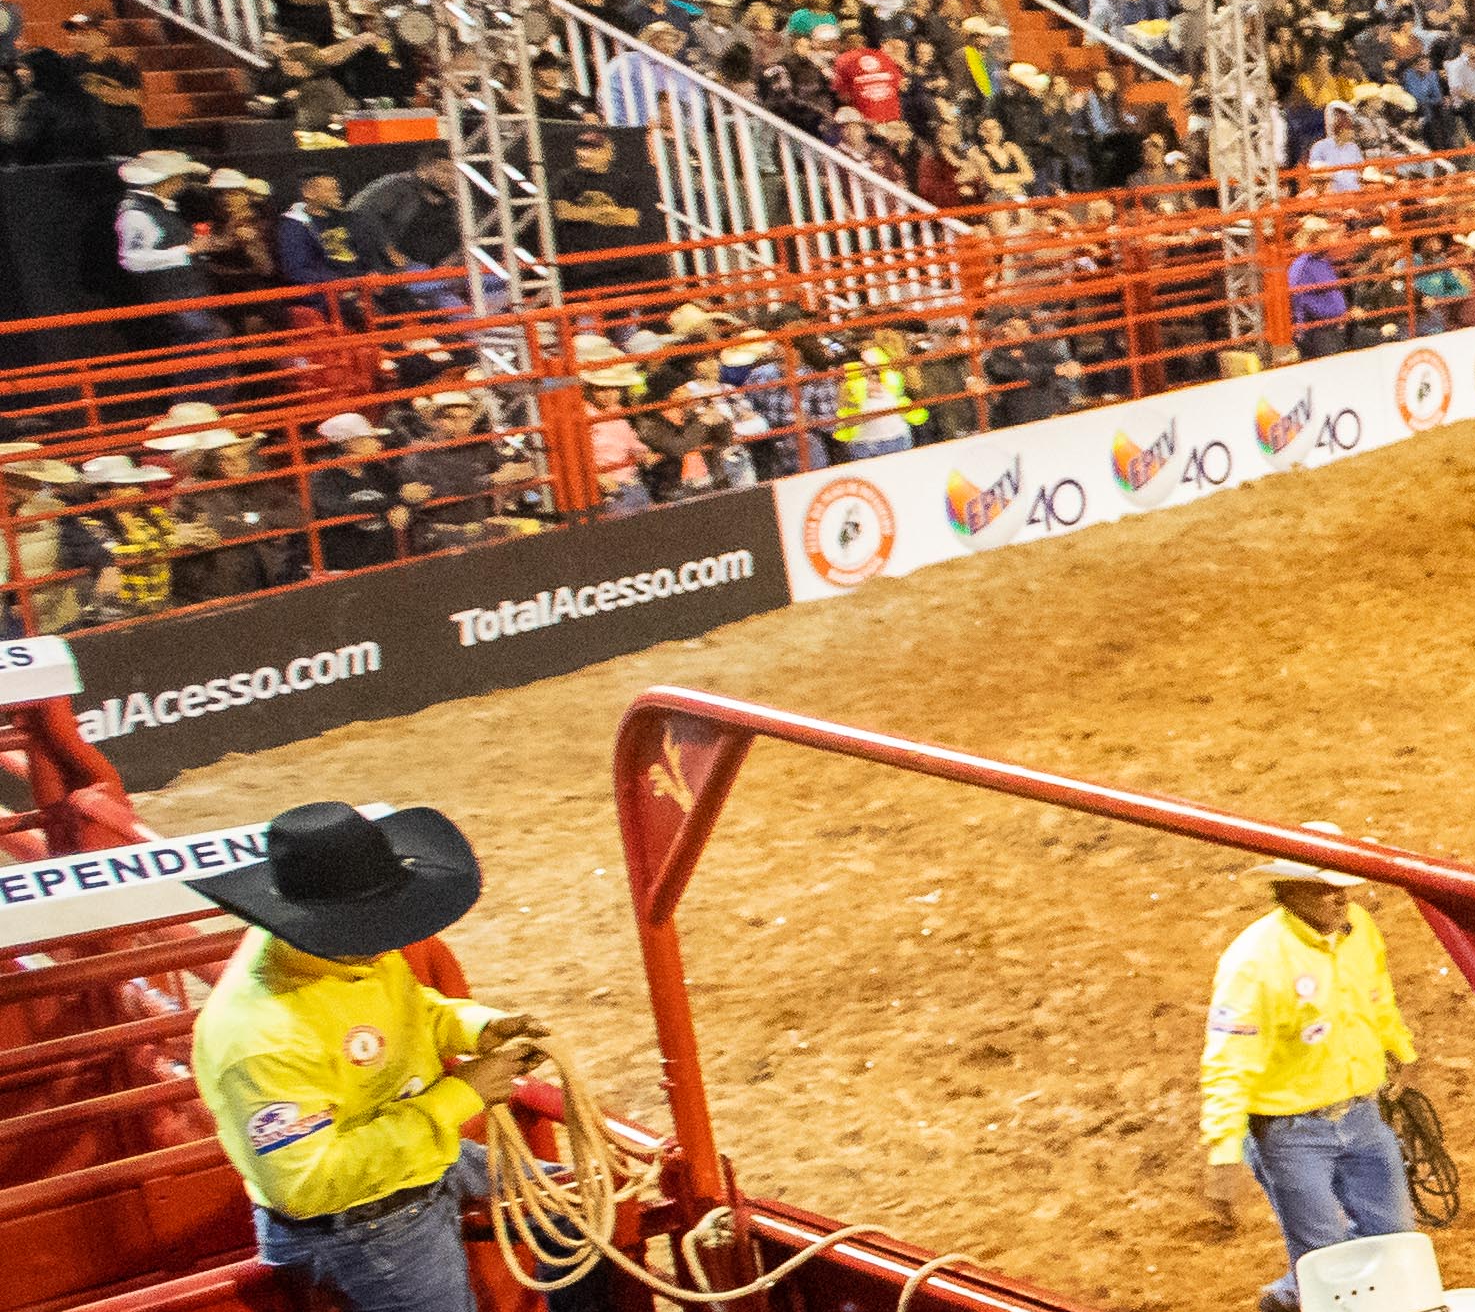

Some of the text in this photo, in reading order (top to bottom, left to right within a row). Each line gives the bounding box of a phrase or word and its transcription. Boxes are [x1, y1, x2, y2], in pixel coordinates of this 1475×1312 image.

[1181, 440, 1232, 487] 40
[1314, 408, 1361, 454] 40
[965, 452, 1021, 536] EPTV
[1026, 477, 1087, 532] 40
[449, 548, 755, 648] TotalAcesso.com
[76, 639, 382, 745] alAcesso.com
